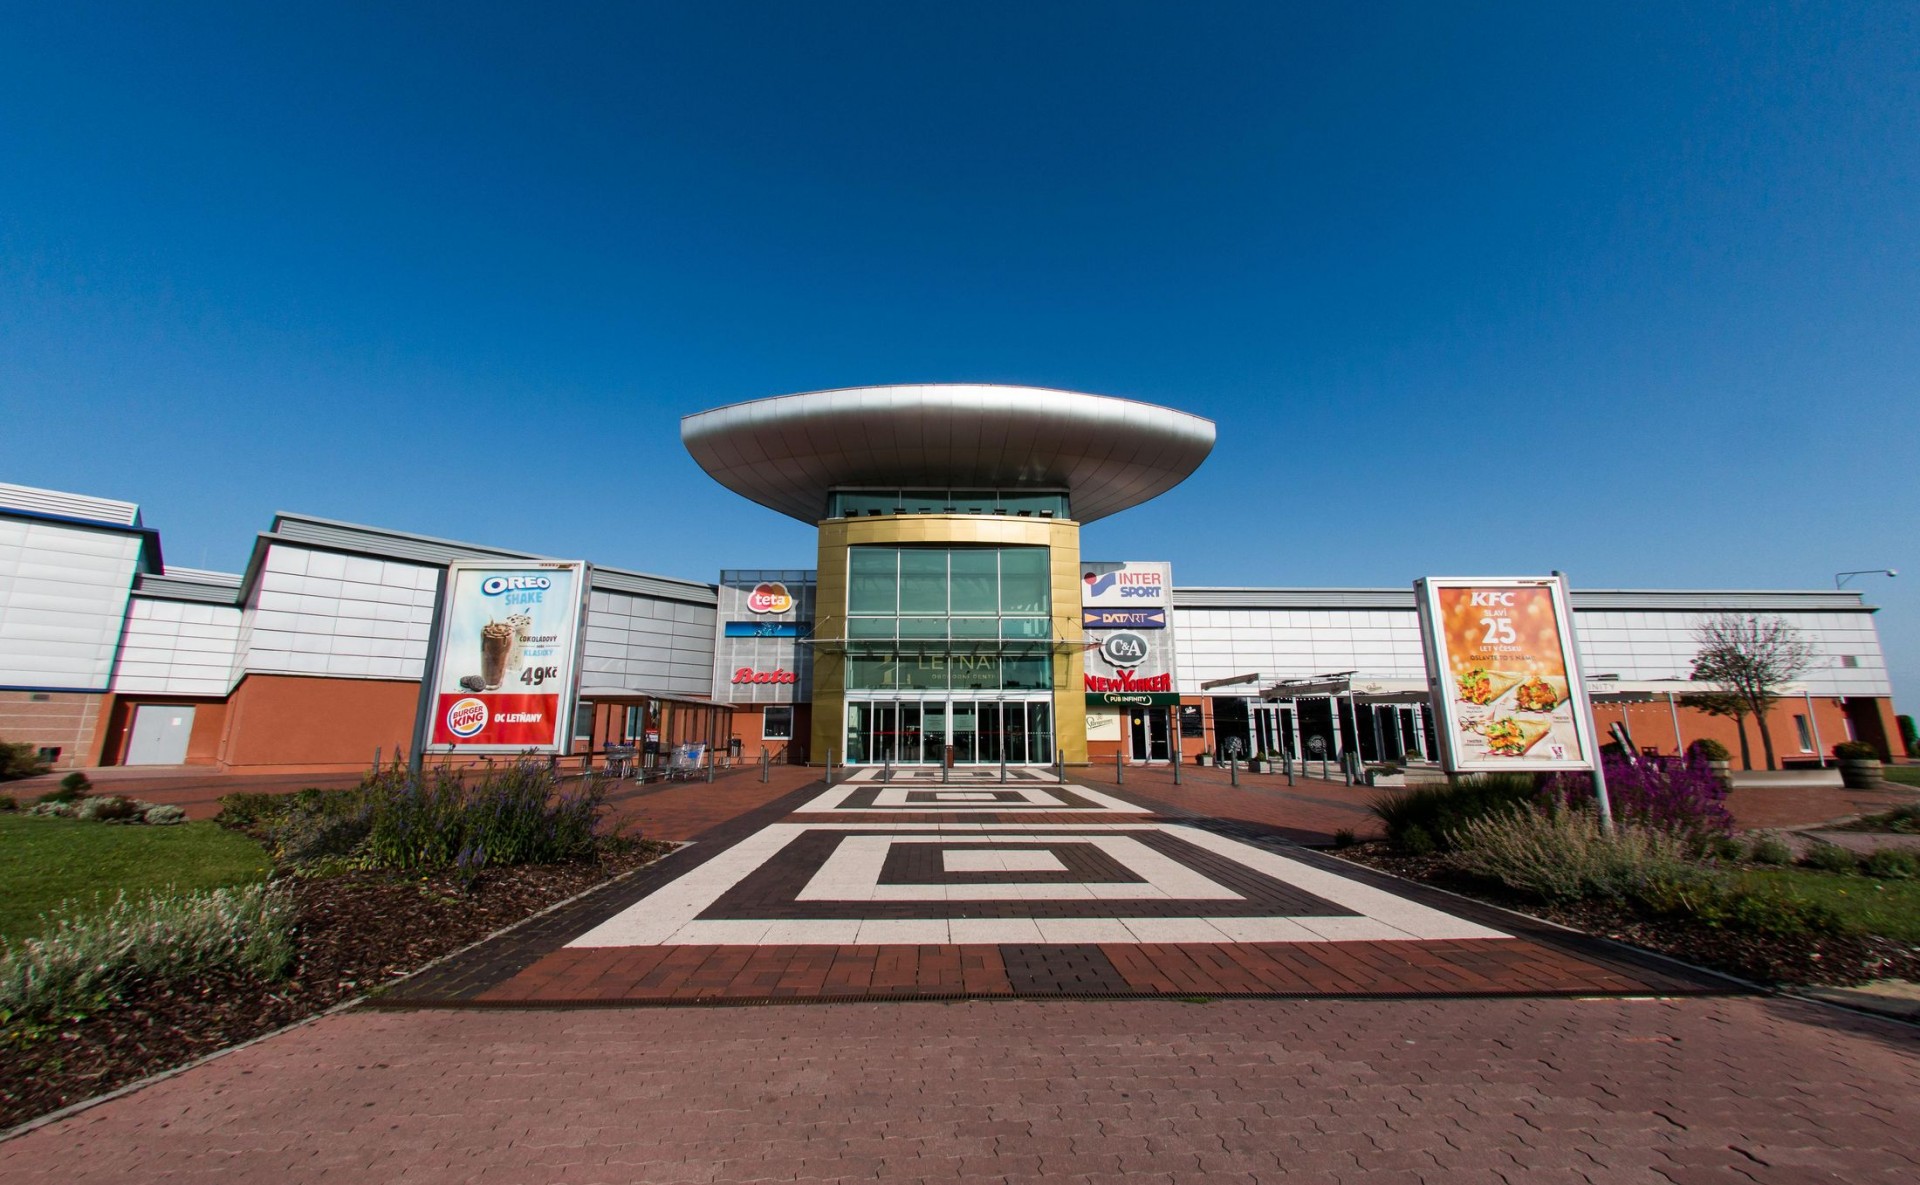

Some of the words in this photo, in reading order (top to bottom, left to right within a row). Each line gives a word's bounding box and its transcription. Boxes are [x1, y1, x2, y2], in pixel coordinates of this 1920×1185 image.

[482, 576, 551, 596] OREO
[1119, 573, 1161, 585] INTER
[505, 591, 542, 606] SHAKE
[1120, 586, 1161, 598] SPORT
[1470, 591, 1515, 607] KFC
[755, 594, 786, 606] teta
[1102, 613, 1147, 623] DATART
[1480, 617, 1516, 645] 25
[1110, 639, 1142, 656] C&A
[731, 667, 798, 684] Bata
[453, 705, 483, 719] BURGER
[494, 713, 506, 723] OC
[507, 711, 542, 723] LETŇANY
[453, 712, 484, 729] KING
